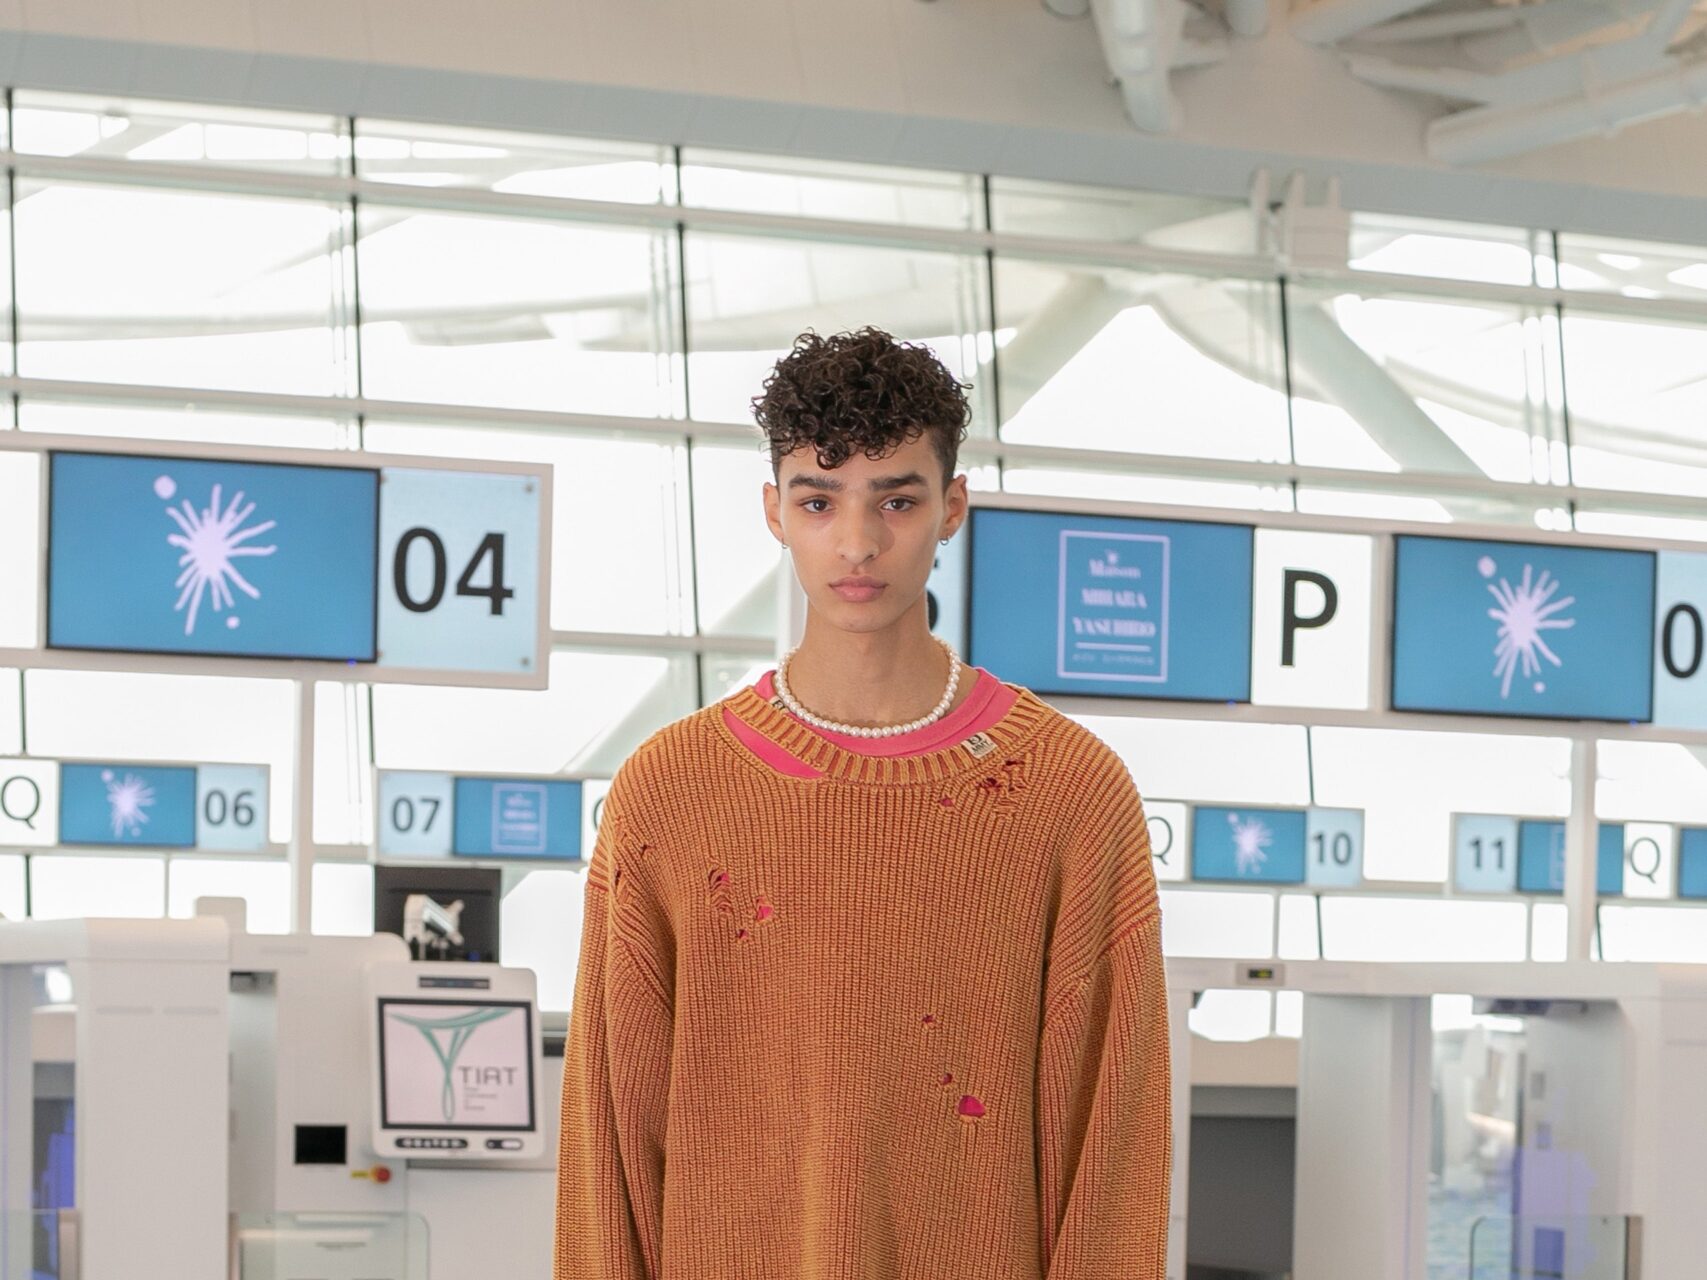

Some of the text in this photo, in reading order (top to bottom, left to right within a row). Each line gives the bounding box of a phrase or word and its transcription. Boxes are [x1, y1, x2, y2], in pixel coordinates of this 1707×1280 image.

[394, 527, 513, 616] 04
[1282, 569, 1338, 666] P
[1, 776, 40, 830] Q
[204, 789, 255, 827] 06
[392, 797, 441, 834] 07
[1147, 816, 1173, 865] Q
[1312, 831, 1353, 866] 10
[1469, 835, 1505, 870] 11
[1630, 837, 1661, 884] Q
[458, 1066, 518, 1086] TIAT
